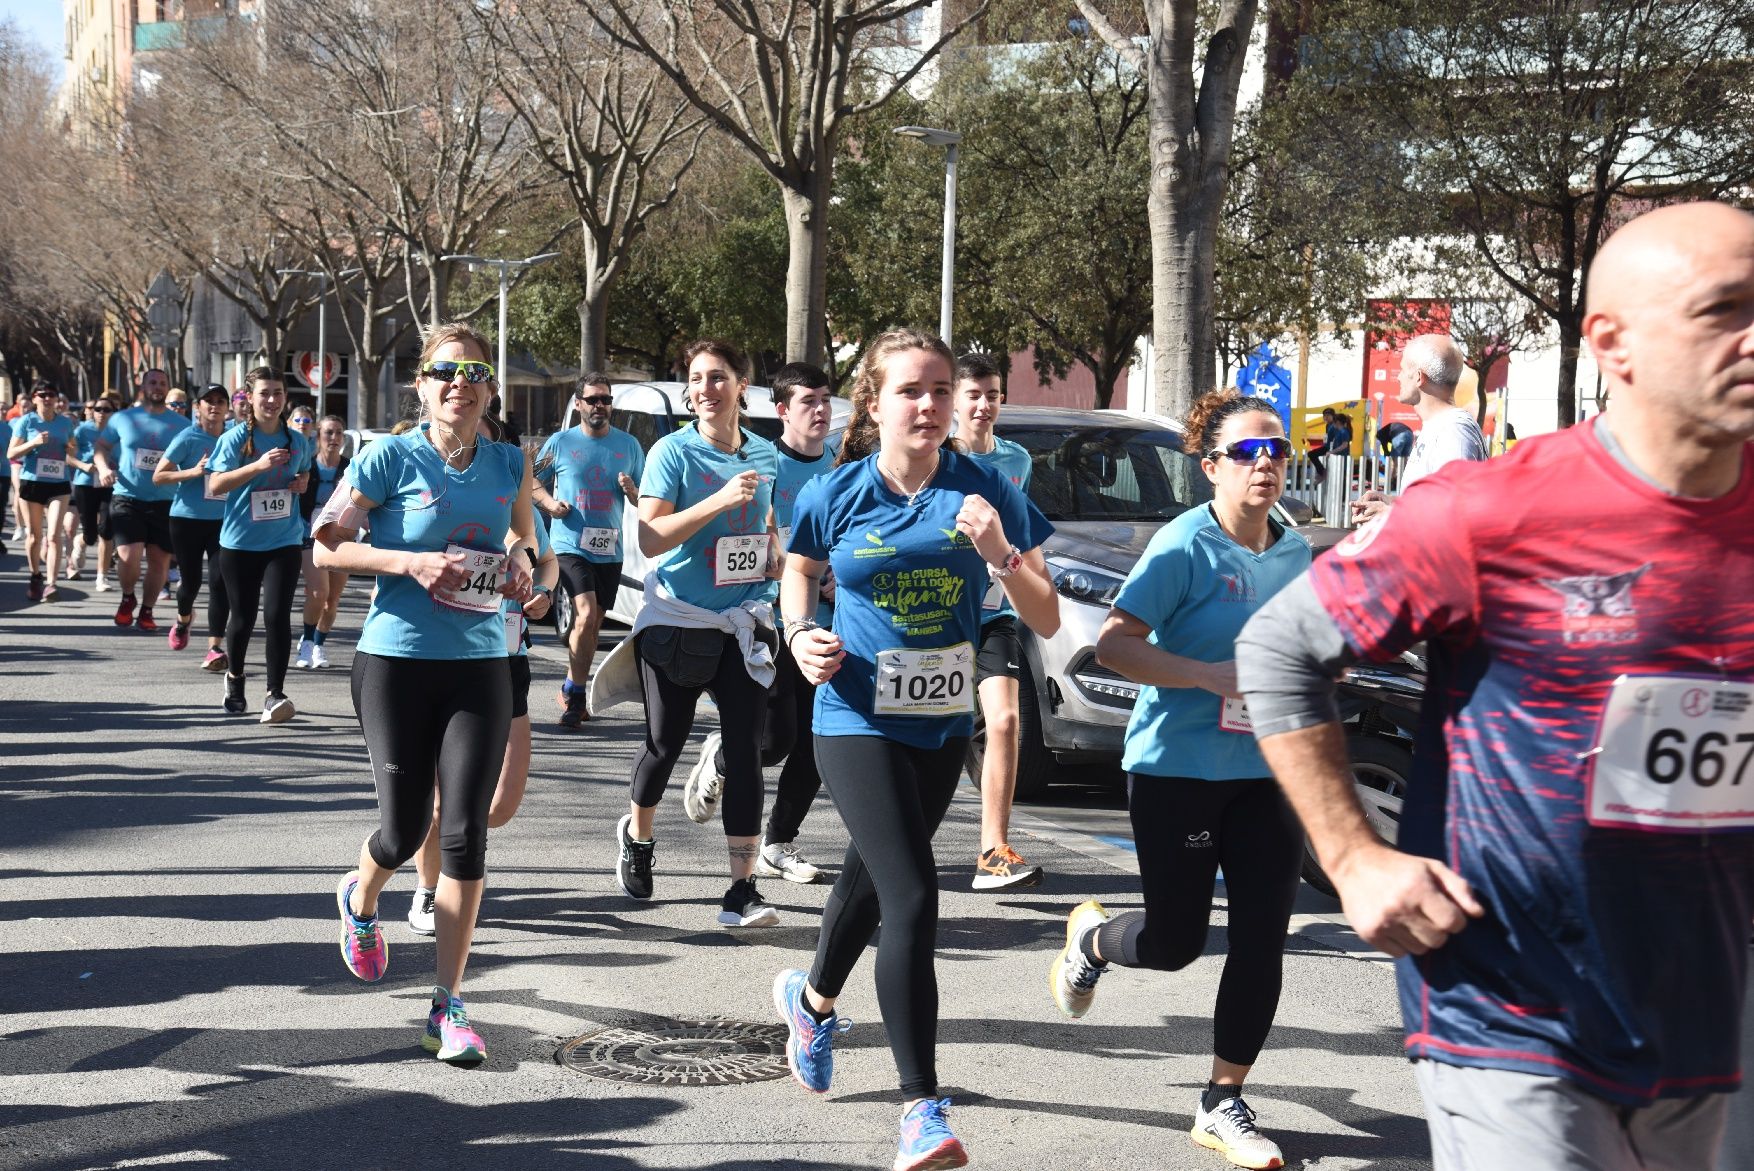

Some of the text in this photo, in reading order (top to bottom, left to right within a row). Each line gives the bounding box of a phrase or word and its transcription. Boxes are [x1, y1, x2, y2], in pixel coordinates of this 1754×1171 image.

[261, 499, 285, 512] 149
[727, 551, 757, 571] 529
[897, 576, 960, 588] DE LA DONA
[911, 568, 949, 579] CURSA
[872, 579, 964, 614] infantil
[889, 670, 964, 701] 1020
[1645, 727, 1754, 788] 667
